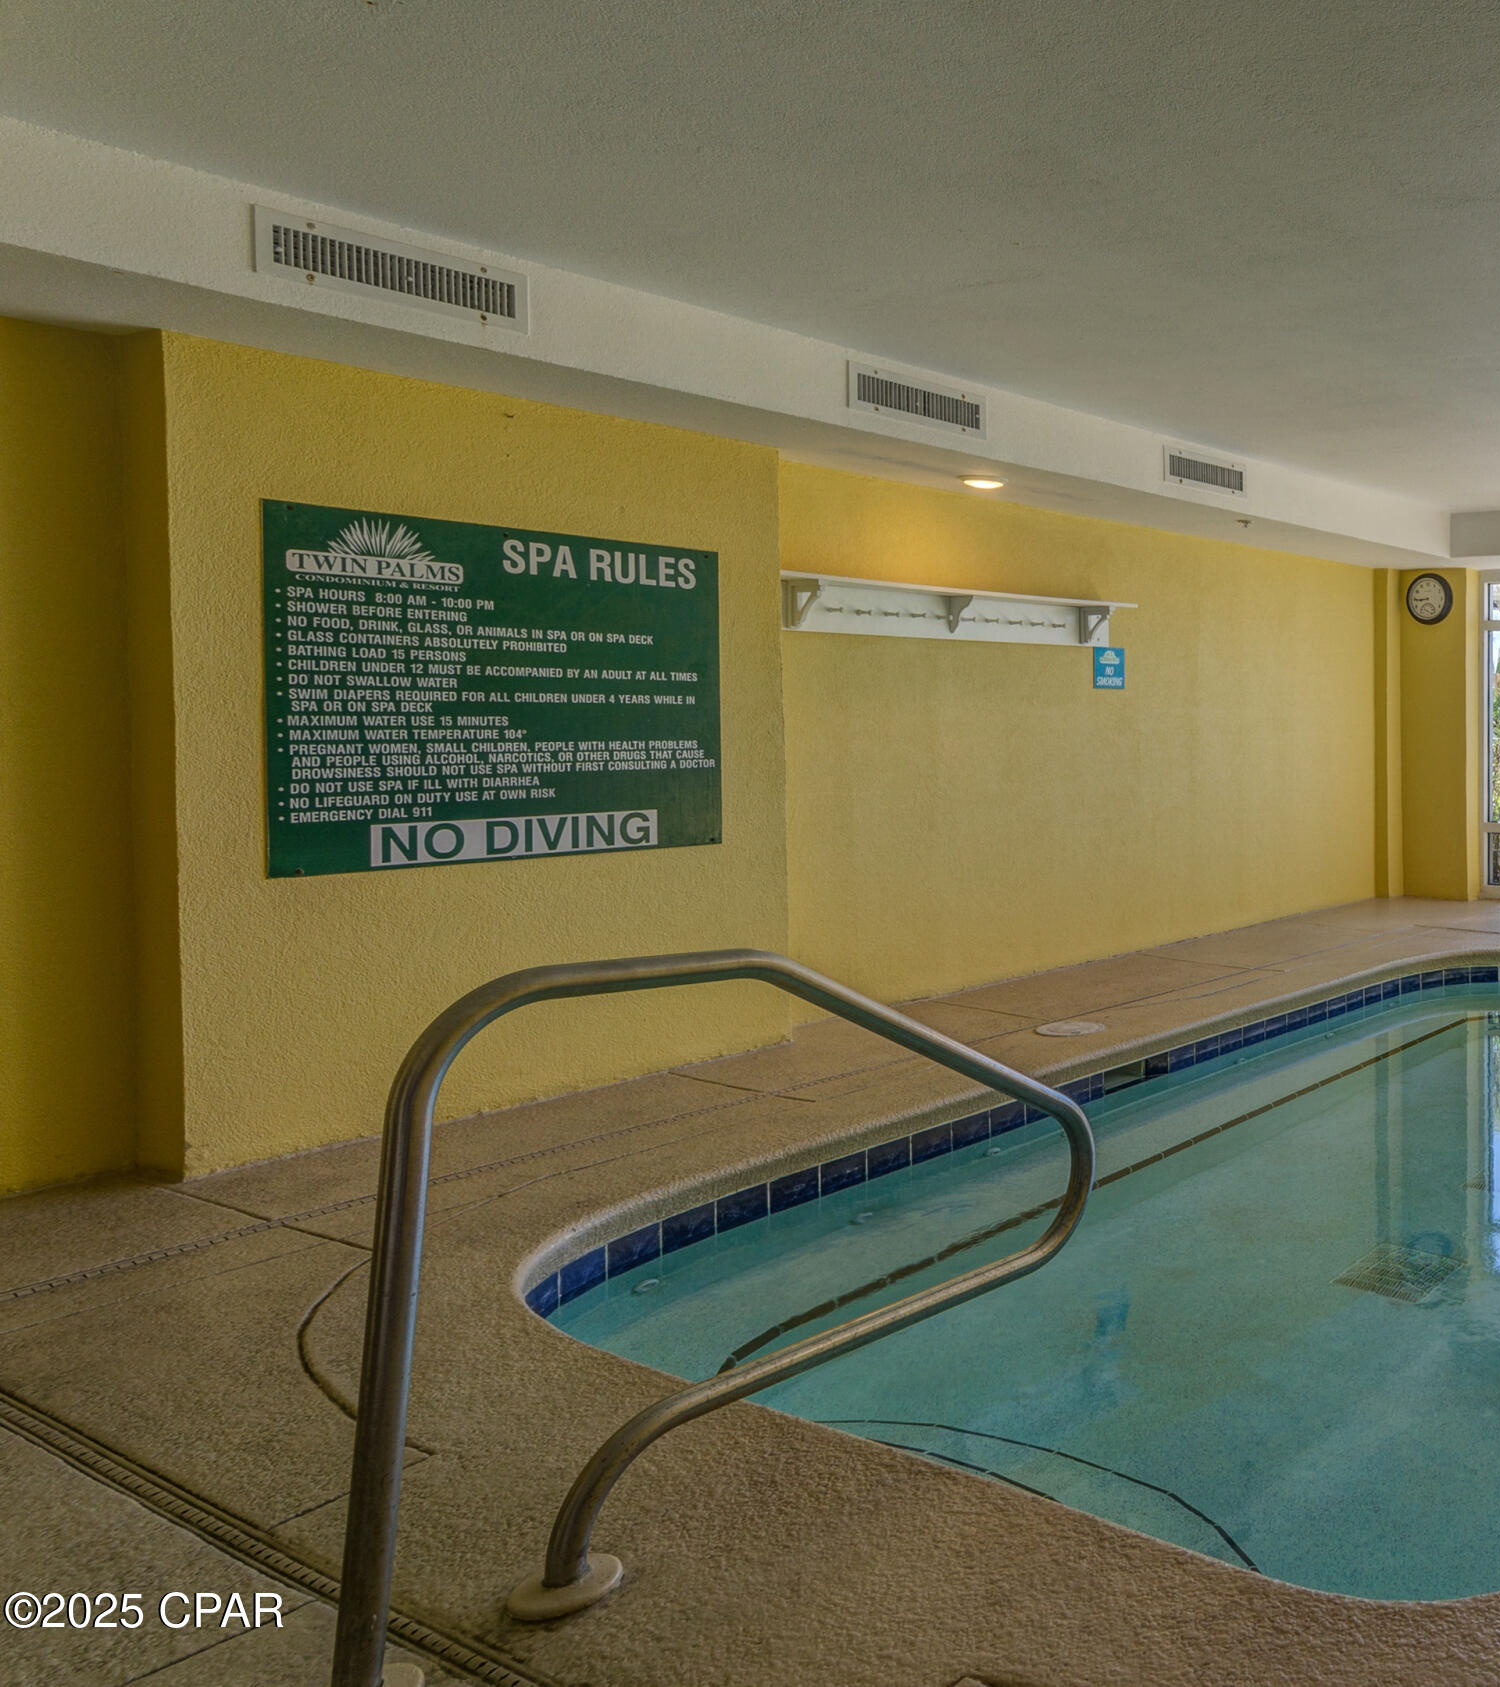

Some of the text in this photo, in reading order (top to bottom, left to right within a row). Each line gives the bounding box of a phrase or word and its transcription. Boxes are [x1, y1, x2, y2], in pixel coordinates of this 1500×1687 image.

[292, 552, 461, 582] TWIN PALMS
[502, 539, 697, 590] SPA RULES
[295, 573, 461, 593] CONDOMINIUM & RESORT
[286, 586, 314, 598] SPA
[318, 588, 365, 601] HOURS
[374, 592, 402, 604] 8:00
[406, 594, 426, 605] AM
[440, 597, 472, 608] 10:00
[476, 599, 494, 610] PM
[286, 601, 467, 621] SHOWER BEFORE ENTERING
[287, 615, 653, 644] NO FOOD, DRINK, GLASS, OR ANIMALS IN SPA OR ON SPA DECK
[286, 630, 567, 652] GLASS CONTAINERS ABSOLUTELY PROHIBITED
[287, 645, 466, 661] BATHING LOAD 15 PERSONS
[287, 659, 698, 681] CHILDREN UNDER 12 MUST BE ACCOMPANIED BY AN ADULT AT ALL TIMES
[1105, 666, 1115, 676] NO
[288, 673, 457, 688] DO NOT SWALLOW WATER
[288, 688, 695, 704] SWIM DIAPERS REQUIRED FOR ALL CHILDREN UNDER 4 YEARS WHILE IN
[290, 700, 432, 712] SPA OR ON SPA DECK
[286, 715, 508, 726] MAXIMUM WATER USE 15 MINUTES
[288, 729, 359, 740] MAXIMUM
[364, 729, 408, 739] WATER
[411, 729, 499, 739] TEMPERATURE
[289, 740, 698, 754] PREGNANT WOMEN, SMALL CHILDREN, PEOPLE WITH HEALTH PROBLEMS
[291, 749, 707, 767] AND PEOPLE USING ALCOHOL, NARCOTICS, OR OTHER DRUGS THAT CAUSE
[291, 758, 716, 779] DROWSINESS SHOULD NOT USE SPA WITHOUT FIRST CONSULTING A DOCTOR
[289, 776, 540, 794] DO NOT USE SPA IF ILL WITH DIARRHEA
[289, 788, 556, 808] NO LIFEGUARD ON DUTY USE AT OWN RISK
[290, 806, 432, 823] EMERGENCY DIAL 911
[381, 812, 650, 864] NO DIVING
